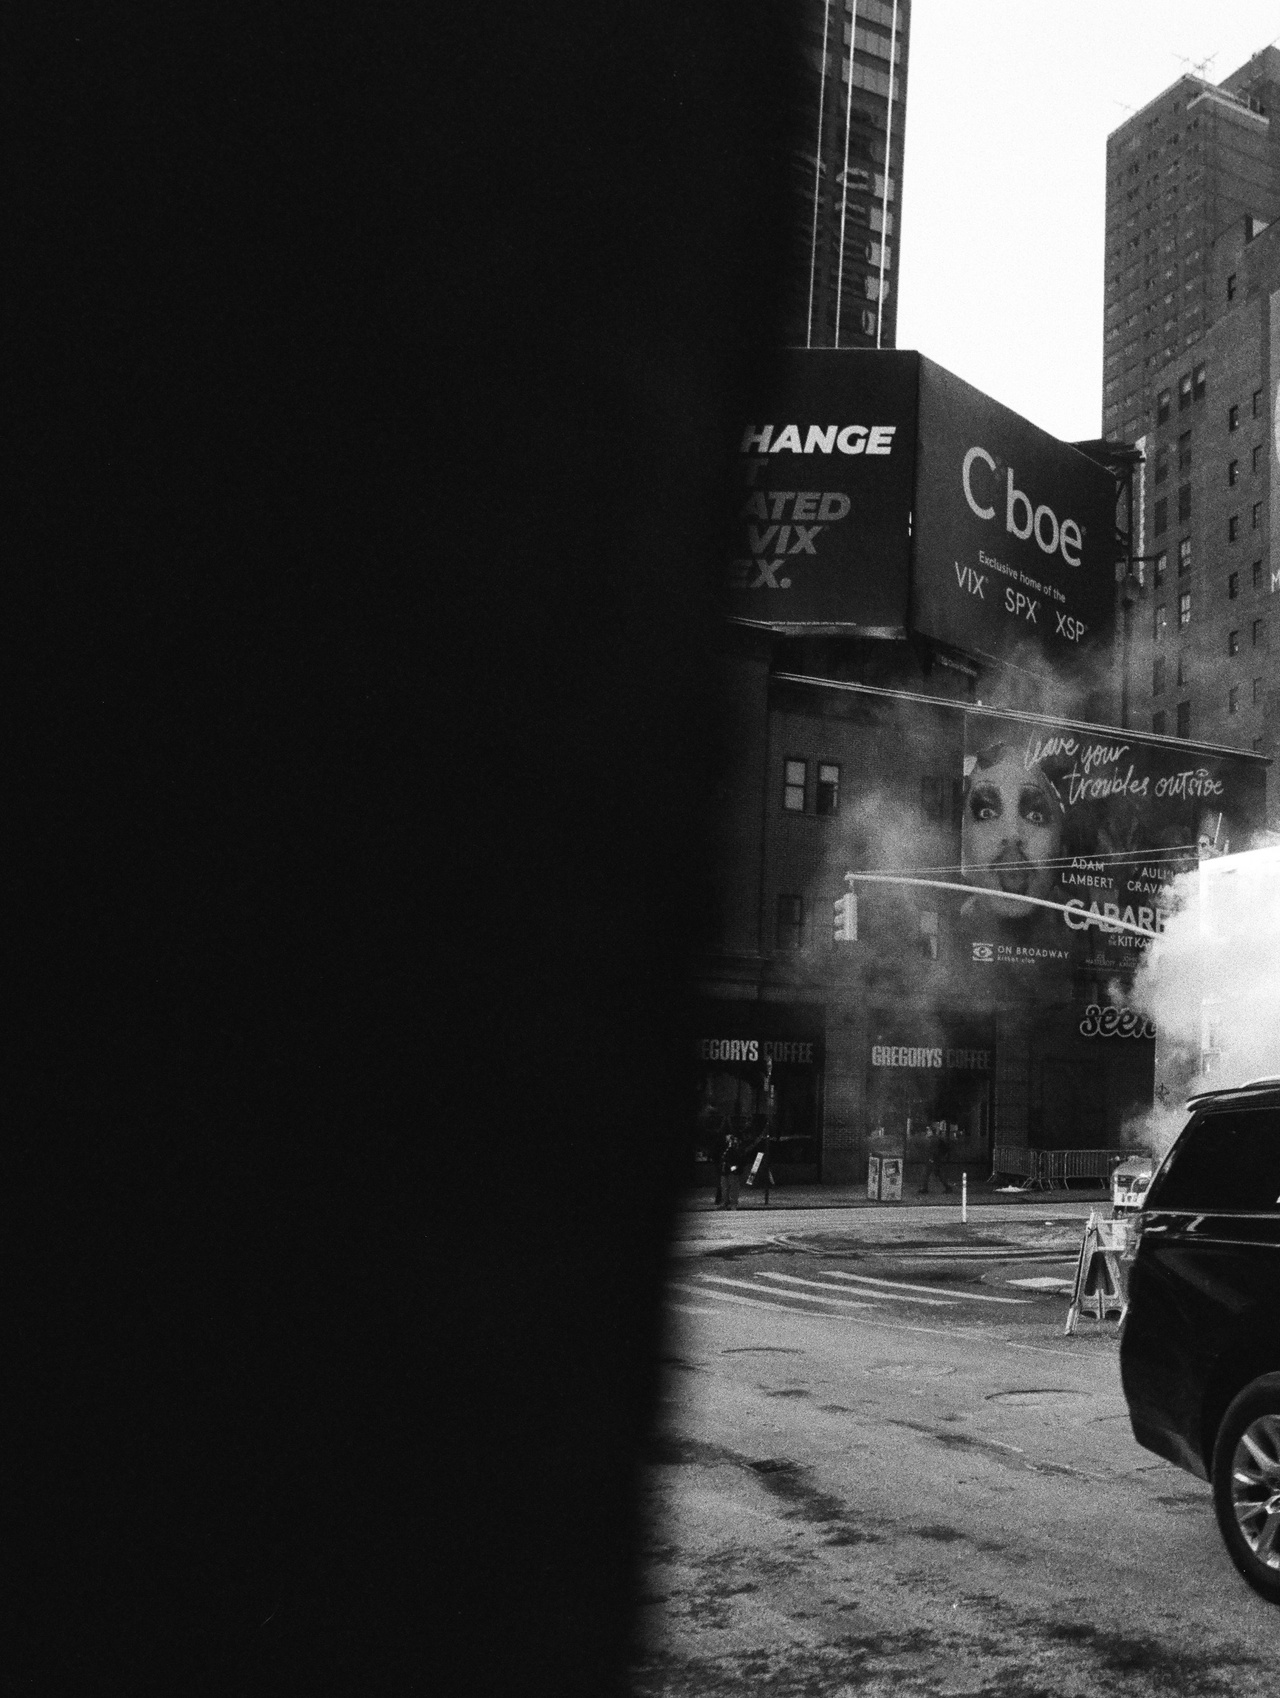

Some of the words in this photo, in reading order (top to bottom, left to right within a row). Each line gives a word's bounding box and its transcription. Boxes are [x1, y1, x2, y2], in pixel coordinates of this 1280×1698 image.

[962, 446, 1083, 567] Cboe
[979, 550, 1018, 580] Exclusive
[1020, 570, 1042, 591] home
[1043, 585, 1052, 596] of
[1053, 588, 1066, 603] the
[1071, 857, 1105, 872] ADAM
[1061, 872, 1114, 889] LAMBERT
[1118, 935, 1134, 947] KIT
[997, 945, 1012, 955] ON
[1016, 946, 1069, 960] BROADWAY
[871, 1044, 943, 1068] GREGORYS
[947, 1047, 992, 1070] COFFEE
